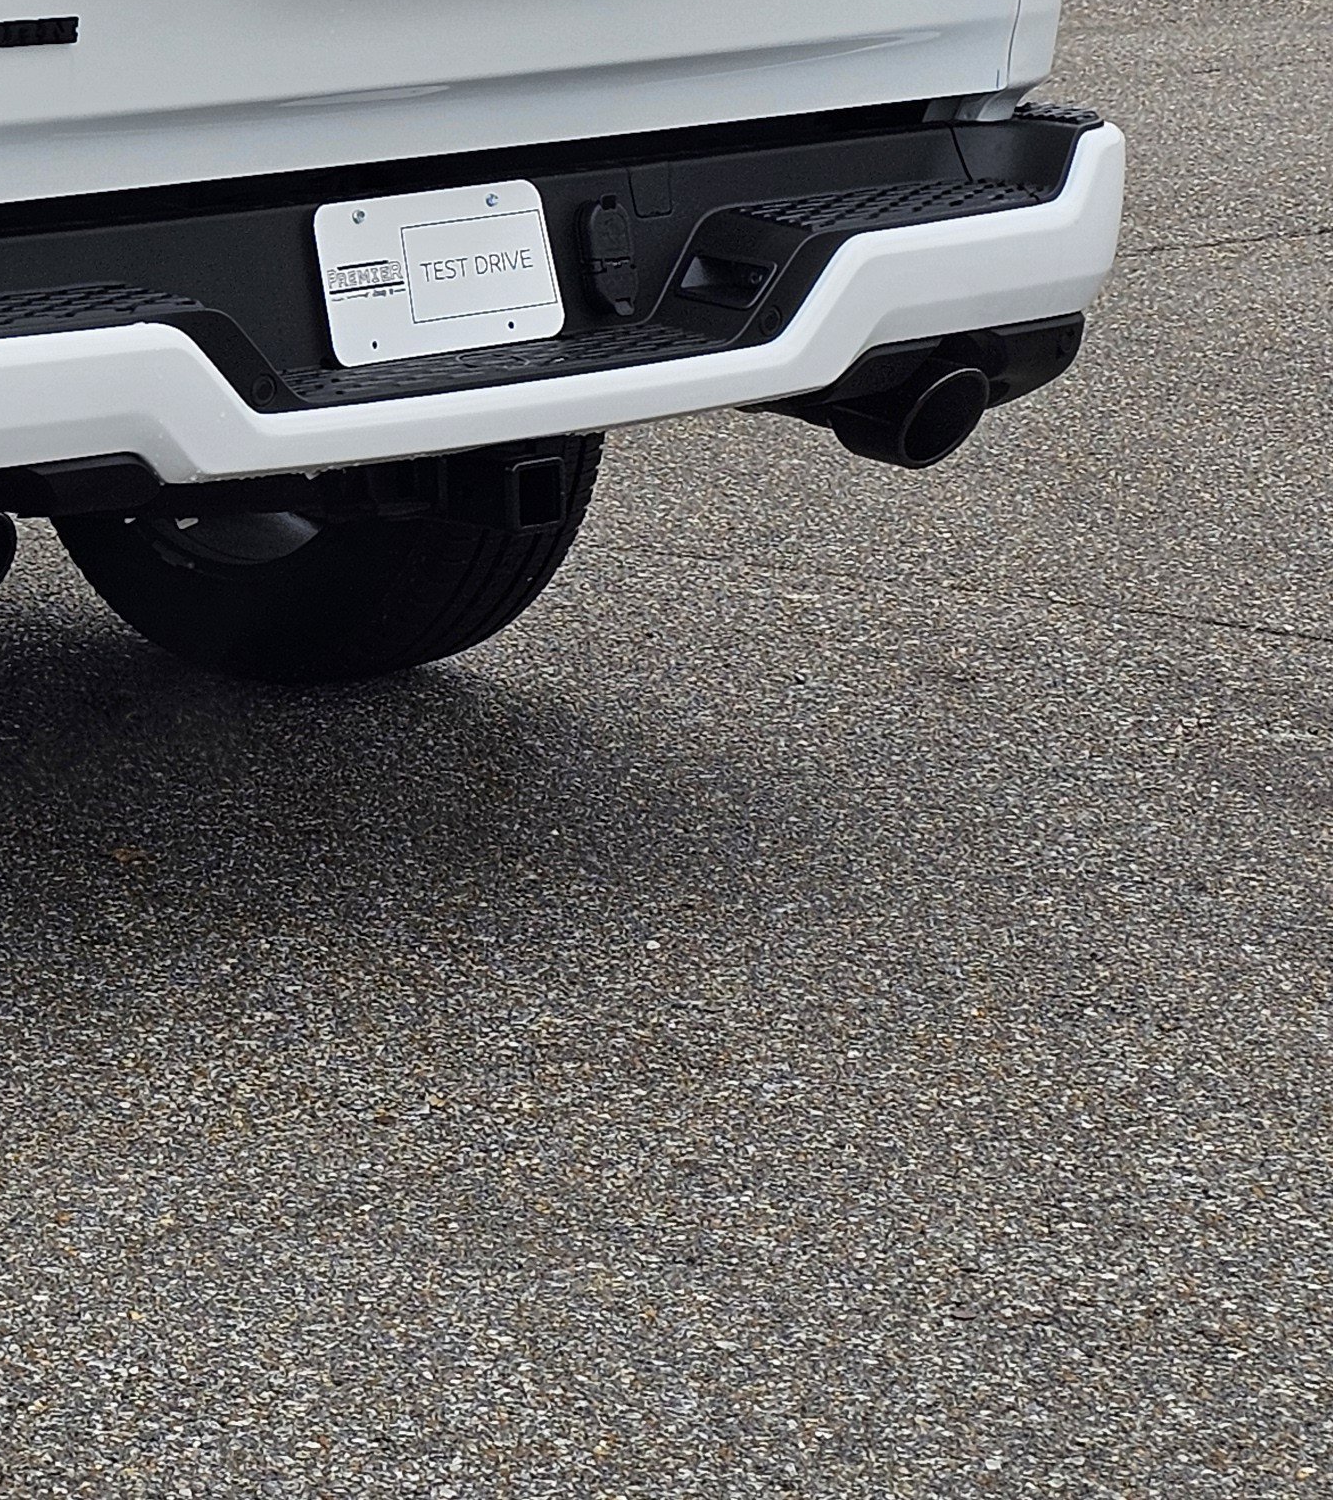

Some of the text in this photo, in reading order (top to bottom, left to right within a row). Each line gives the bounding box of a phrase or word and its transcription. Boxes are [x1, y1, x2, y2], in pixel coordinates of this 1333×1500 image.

[327, 261, 404, 289] PREMIER
[420, 249, 534, 282] TEST DRIVE
